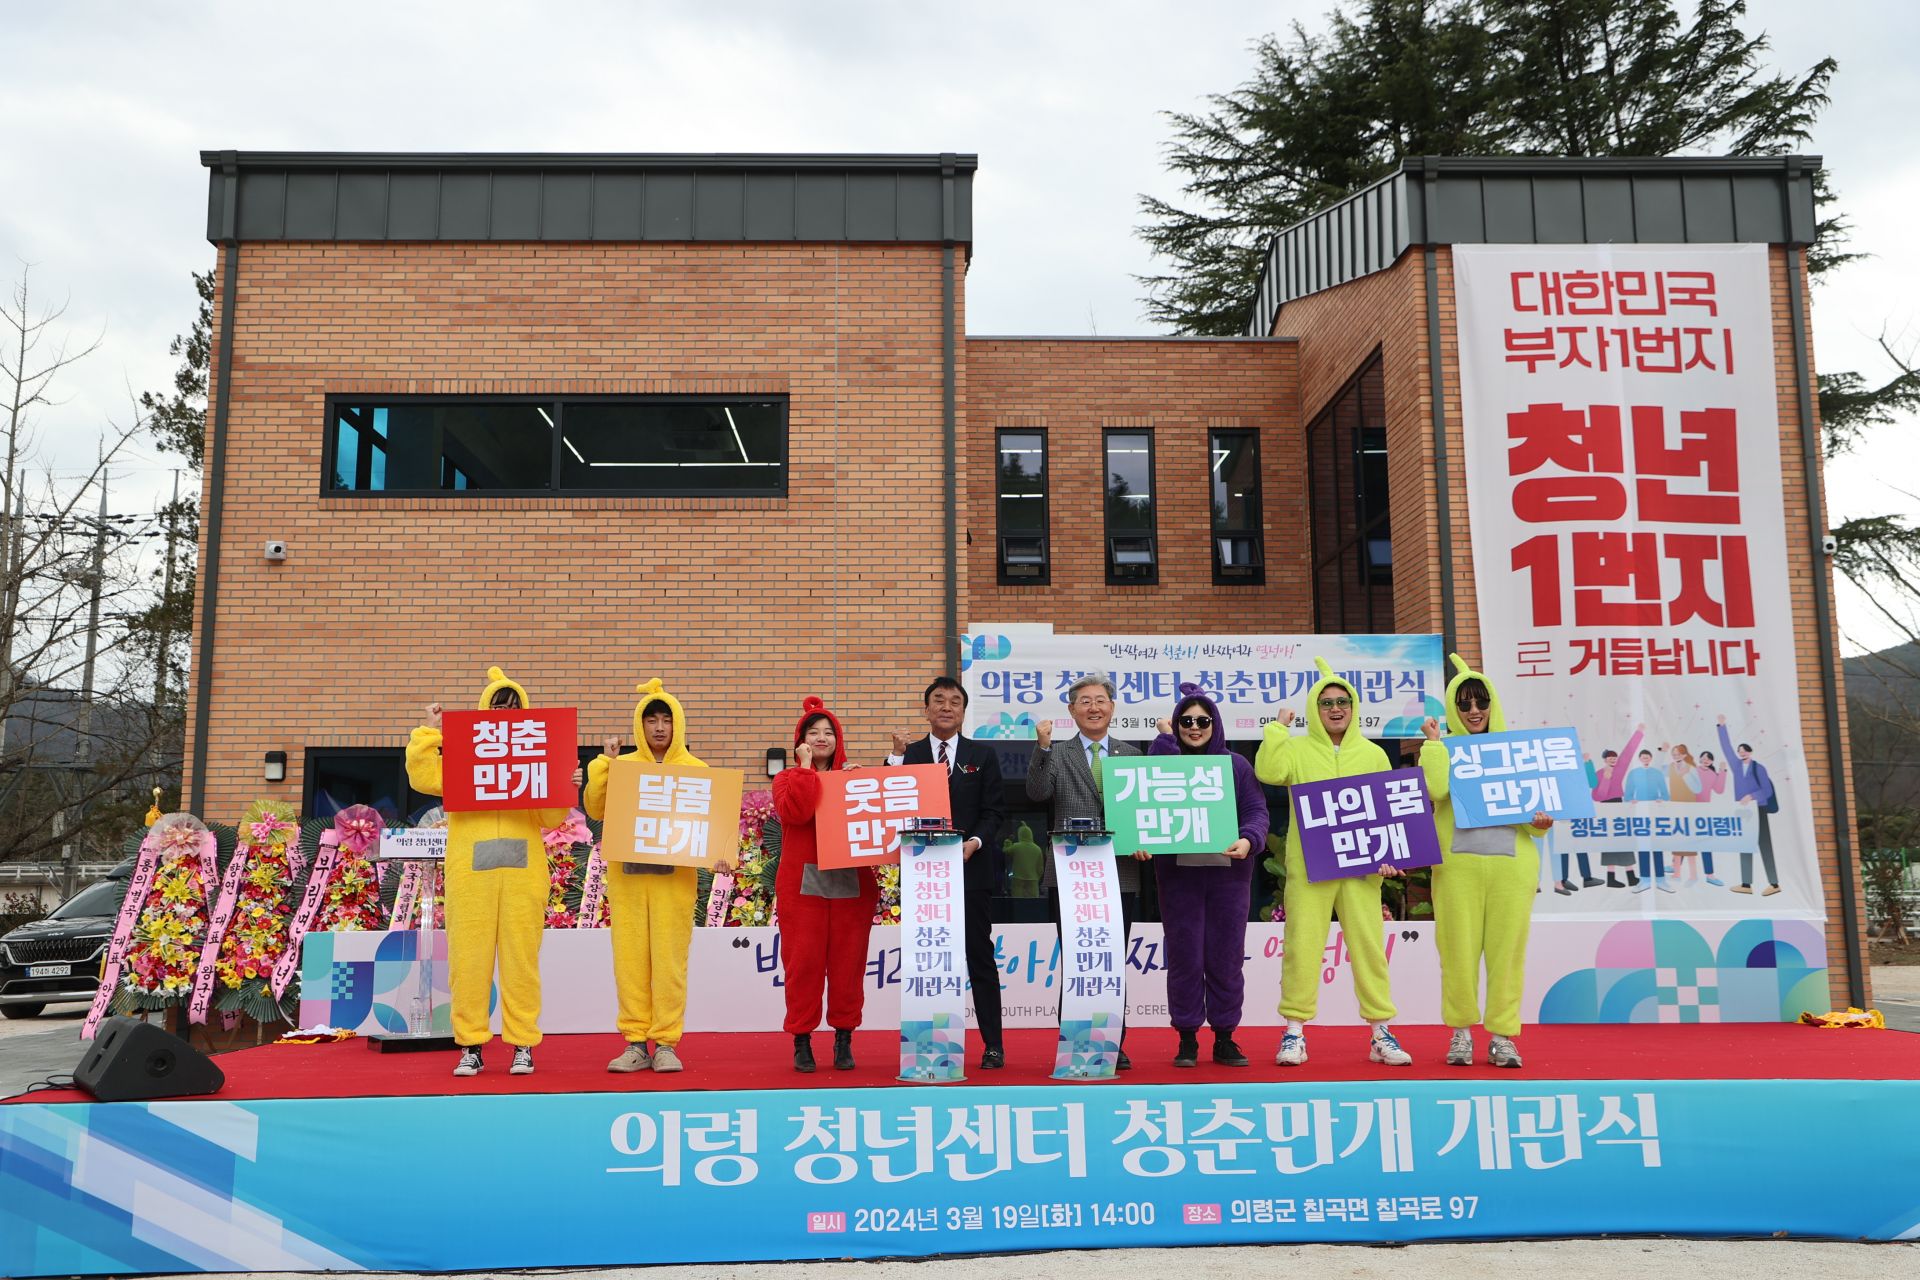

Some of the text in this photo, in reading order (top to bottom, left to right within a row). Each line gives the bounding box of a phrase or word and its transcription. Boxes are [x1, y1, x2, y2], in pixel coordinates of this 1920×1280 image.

[1511, 270, 1718, 316] 대한민국
[1504, 326, 1734, 374] 부자1번지
[1507, 403, 1741, 525] 청년
[1511, 532, 1755, 628] 1번지
[1516, 638, 1760, 677] 로 거듭납니다
[979, 671, 1043, 704] 의령
[473, 719, 546, 758] 청춘
[1121, 718, 1139, 728] 3월
[1366, 717, 1380, 727] 97
[1450, 737, 1579, 779] 싱그러움
[473, 762, 548, 801] 만개
[638, 774, 712, 815] 달콤
[845, 775, 919, 815] 웃음
[1114, 766, 1224, 803] 가능성
[1480, 776, 1563, 817] 만개
[1299, 778, 1424, 830] 나의 꿈
[634, 816, 709, 858] 만개
[1136, 807, 1210, 844] 만개
[1613, 817, 1651, 837] 희망
[1655, 817, 1690, 837] 도시
[1695, 816, 1743, 836] 의령!!
[1331, 823, 1411, 868] 만개
[914, 860, 950, 879] 의령
[1069, 860, 1105, 879] 의령
[914, 881, 951, 900] 청년
[1071, 880, 1107, 900] 청년
[208, 913, 227, 944] 대표
[914, 903, 951, 923] 센터
[1073, 903, 1110, 923] 센터
[109, 936, 126, 964] 대표
[915, 927, 951, 948] 청춘
[1075, 927, 1111, 948] 청춘
[52, 966, 69, 975] 4292
[915, 951, 952, 973] 만개
[1076, 951, 1112, 973] 만개
[192, 965, 215, 1015] 왕군자
[905, 976, 961, 997] 개관식
[1067, 976, 1121, 997] 개관식
[1001, 1007, 1032, 1017] OUTH
[1035, 1006, 1058, 1017] PLA
[1136, 1004, 1167, 1016] CERE
[606, 1093, 1661, 1187] 의령 청년센터 청춘만개 개관식
[812, 1195, 1479, 1232] 일시 2024년 3월 19일[화] 14:00 장소 의령군 칠곡면 칠곡로 97
